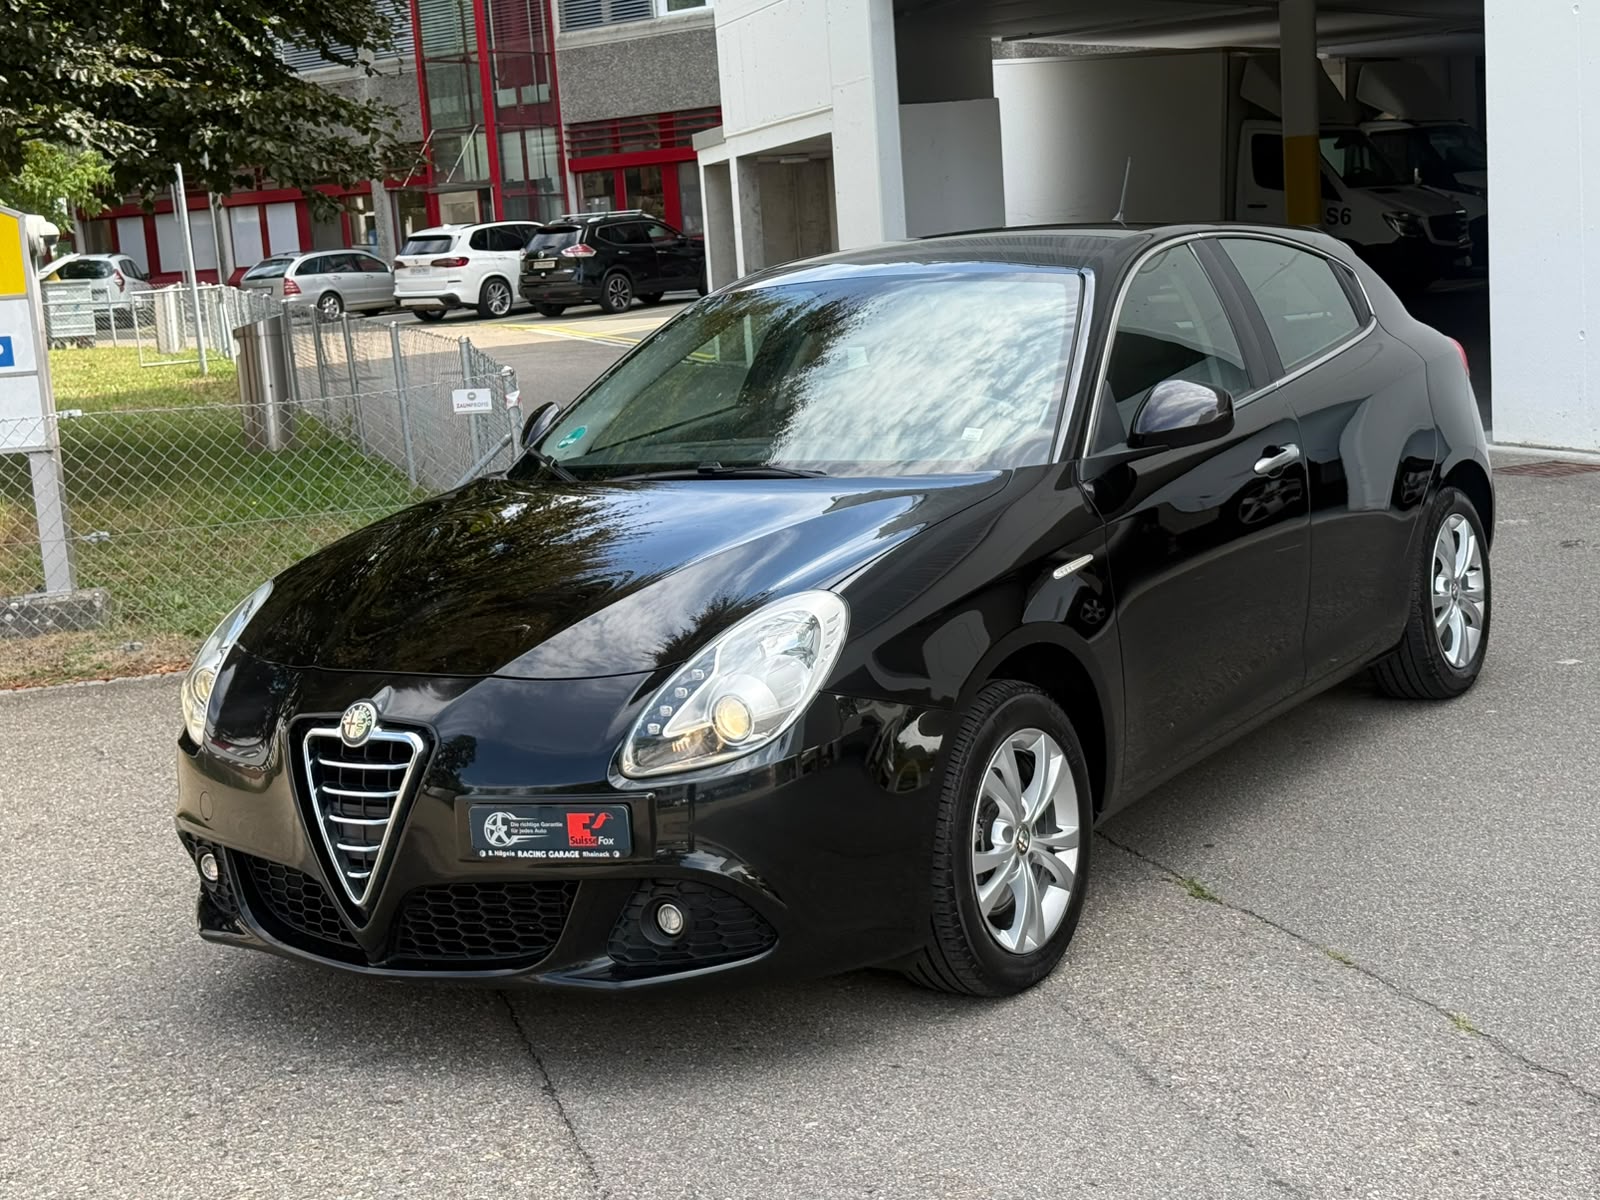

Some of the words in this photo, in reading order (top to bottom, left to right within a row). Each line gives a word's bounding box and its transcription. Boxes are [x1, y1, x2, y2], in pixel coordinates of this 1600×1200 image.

[1326, 207, 1351, 225] S6
[517, 850, 546, 858] RACING
[548, 850, 580, 858] GARAGE
